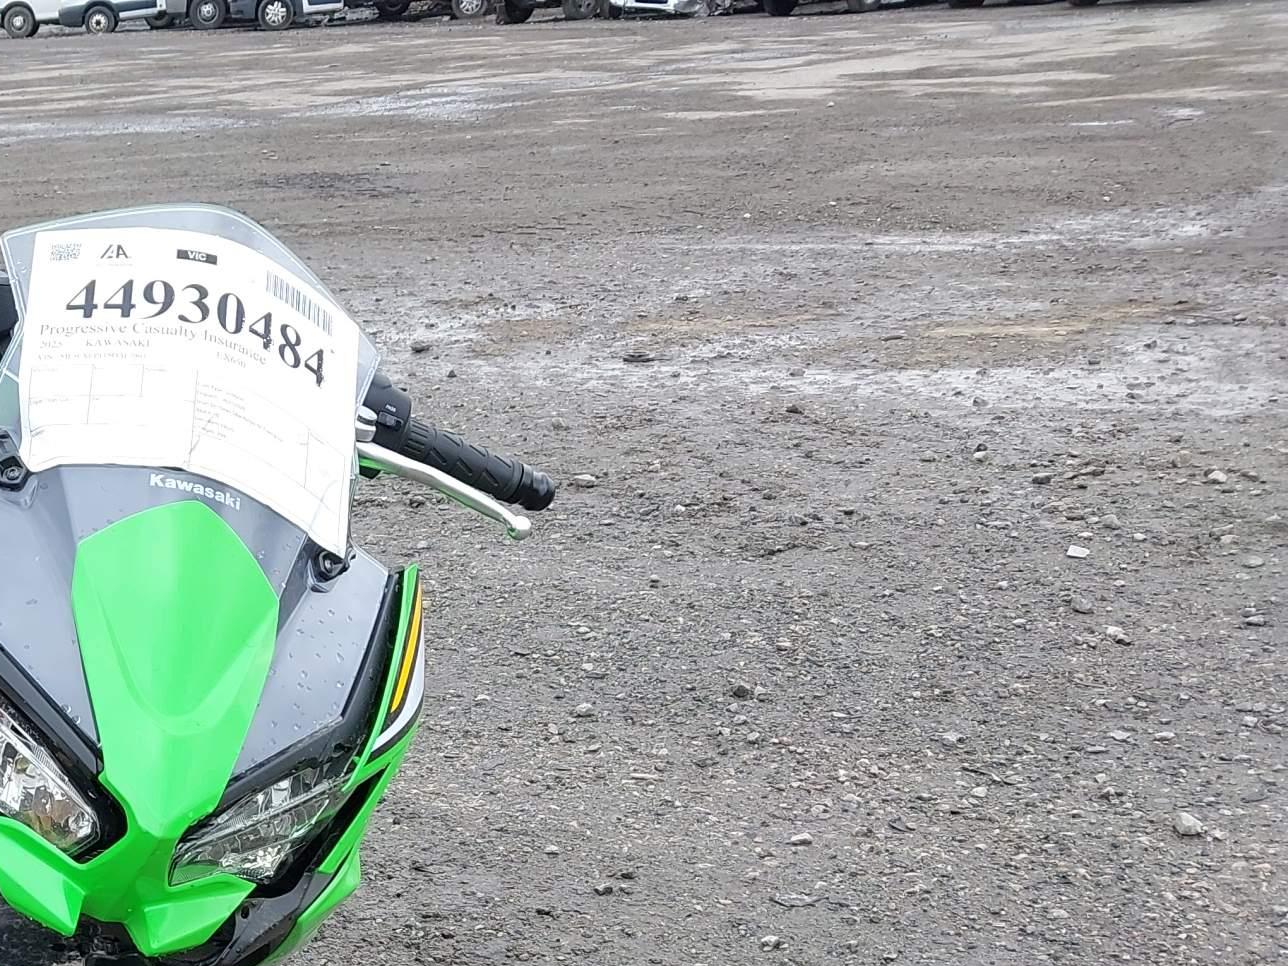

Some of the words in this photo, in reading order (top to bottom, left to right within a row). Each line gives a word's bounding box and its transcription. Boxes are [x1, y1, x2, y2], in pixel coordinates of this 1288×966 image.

[187, 250, 208, 262] VIC
[40, 322, 128, 338] Progressive
[132, 321, 197, 341] Casualty
[203, 328, 268, 365] Insurance
[65, 278, 325, 388] 44930484
[85, 338, 151, 349] KAWASAKI
[149, 473, 241, 511] Kawasaki
